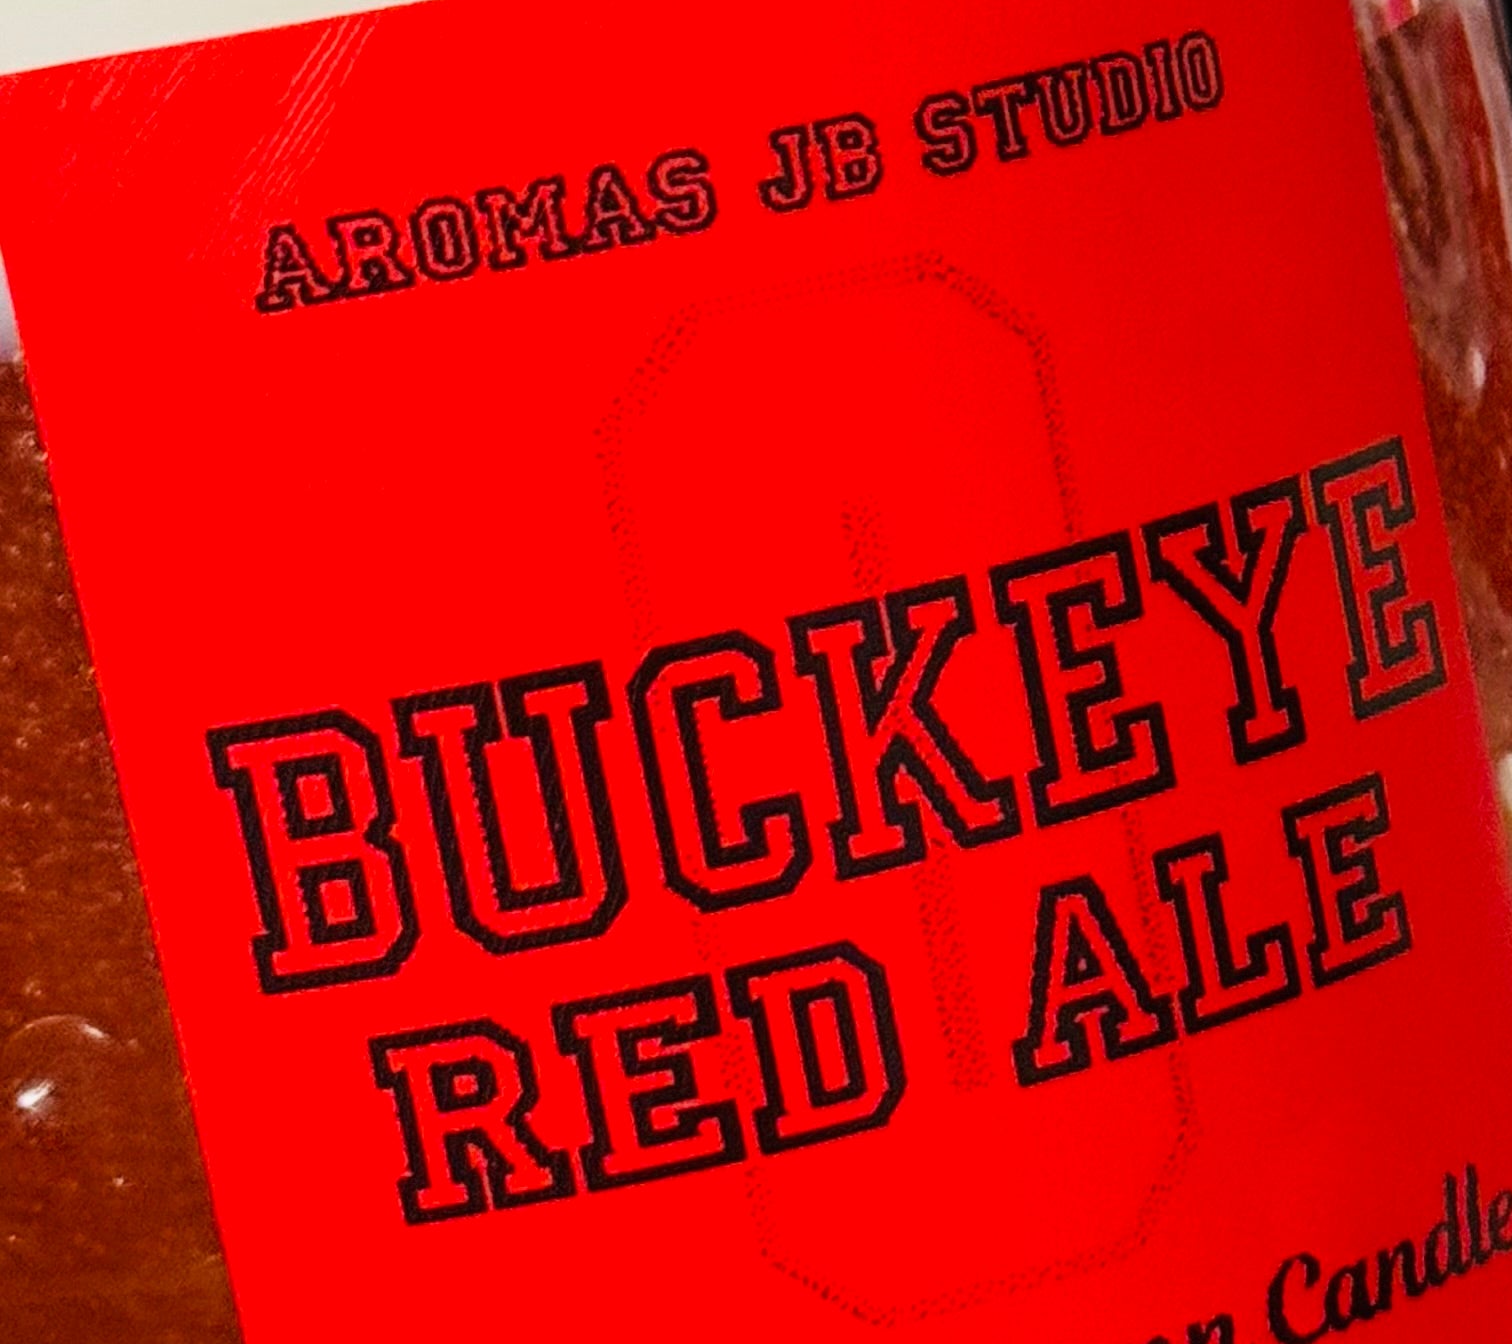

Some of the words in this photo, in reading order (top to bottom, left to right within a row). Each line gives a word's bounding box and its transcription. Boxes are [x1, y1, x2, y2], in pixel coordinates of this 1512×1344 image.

[256, 149, 717, 313] AROMAS
[759, 113, 883, 212] JB
[912, 30, 1224, 177] STUDIO
[206, 435, 1447, 995] BUCKEYE
[369, 940, 906, 1225] RED
[1012, 772, 1412, 1087] ALE
